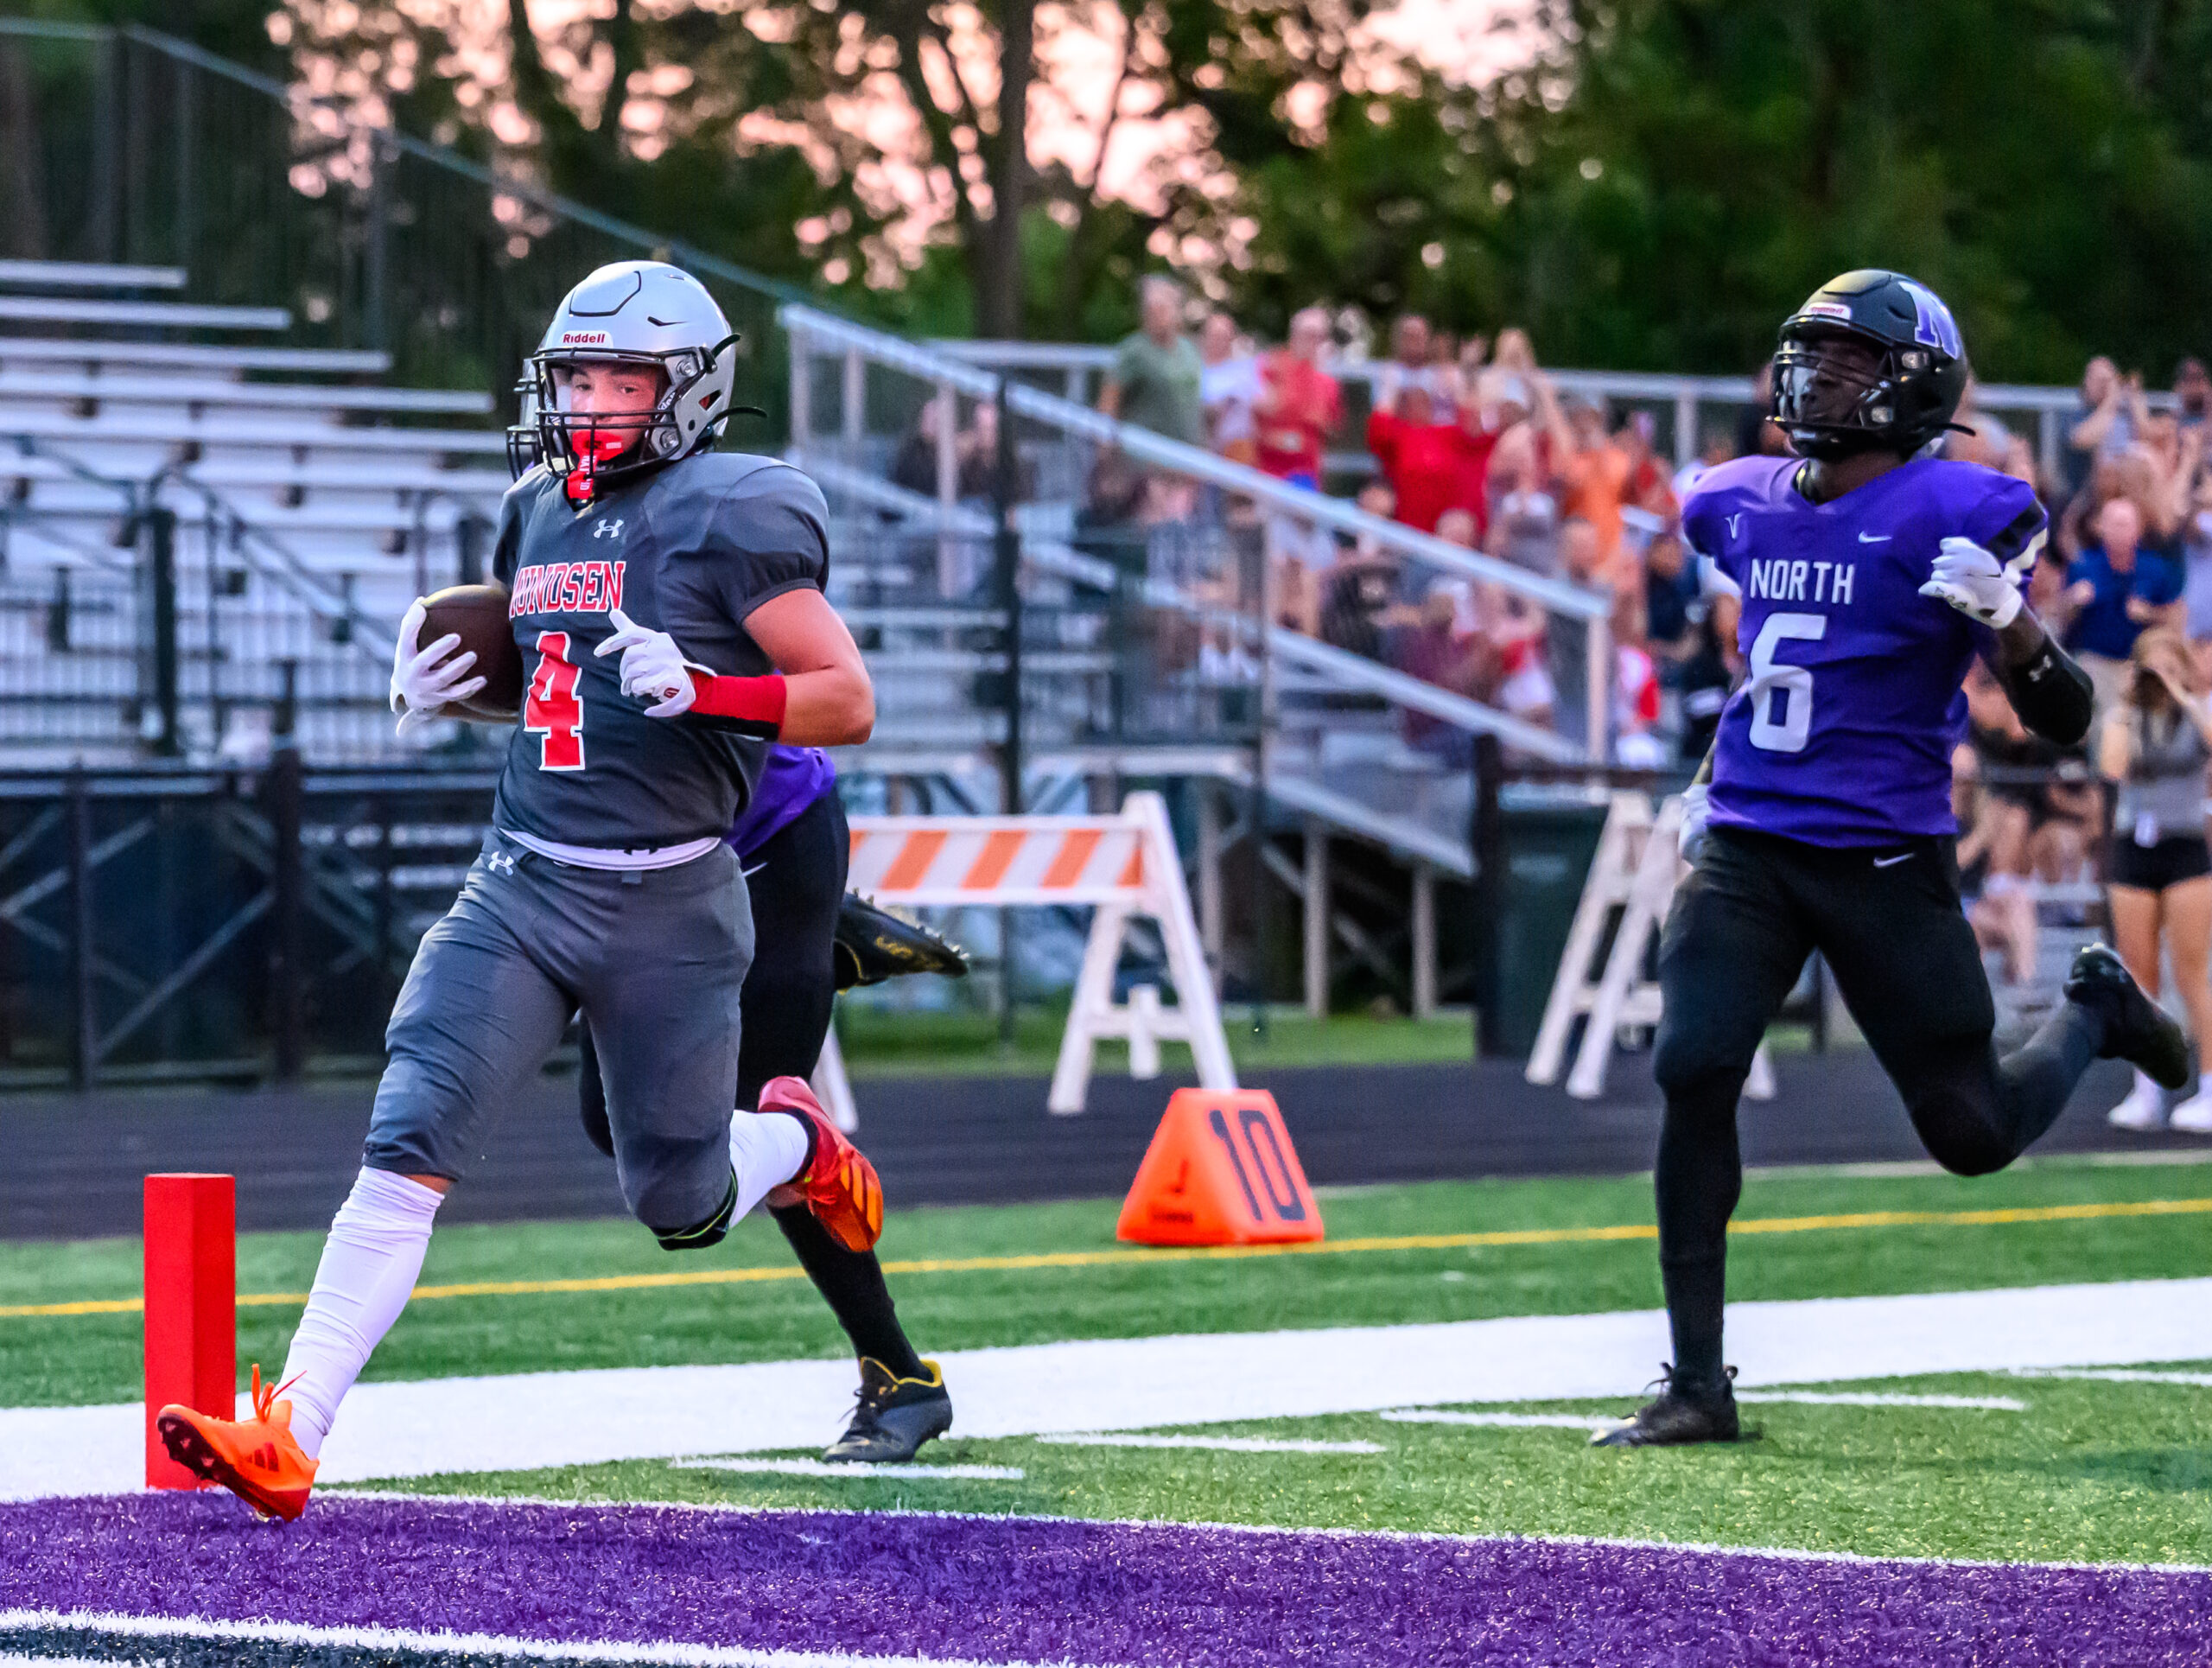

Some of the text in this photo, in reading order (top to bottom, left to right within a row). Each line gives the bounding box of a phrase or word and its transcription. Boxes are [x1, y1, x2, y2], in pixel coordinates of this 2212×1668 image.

[563, 333, 606, 344] Riddell
[1750, 558, 1856, 605] NORTH
[524, 630, 586, 771] 4
[1748, 613, 1827, 754] 6
[1208, 1109, 1306, 1221] 10
